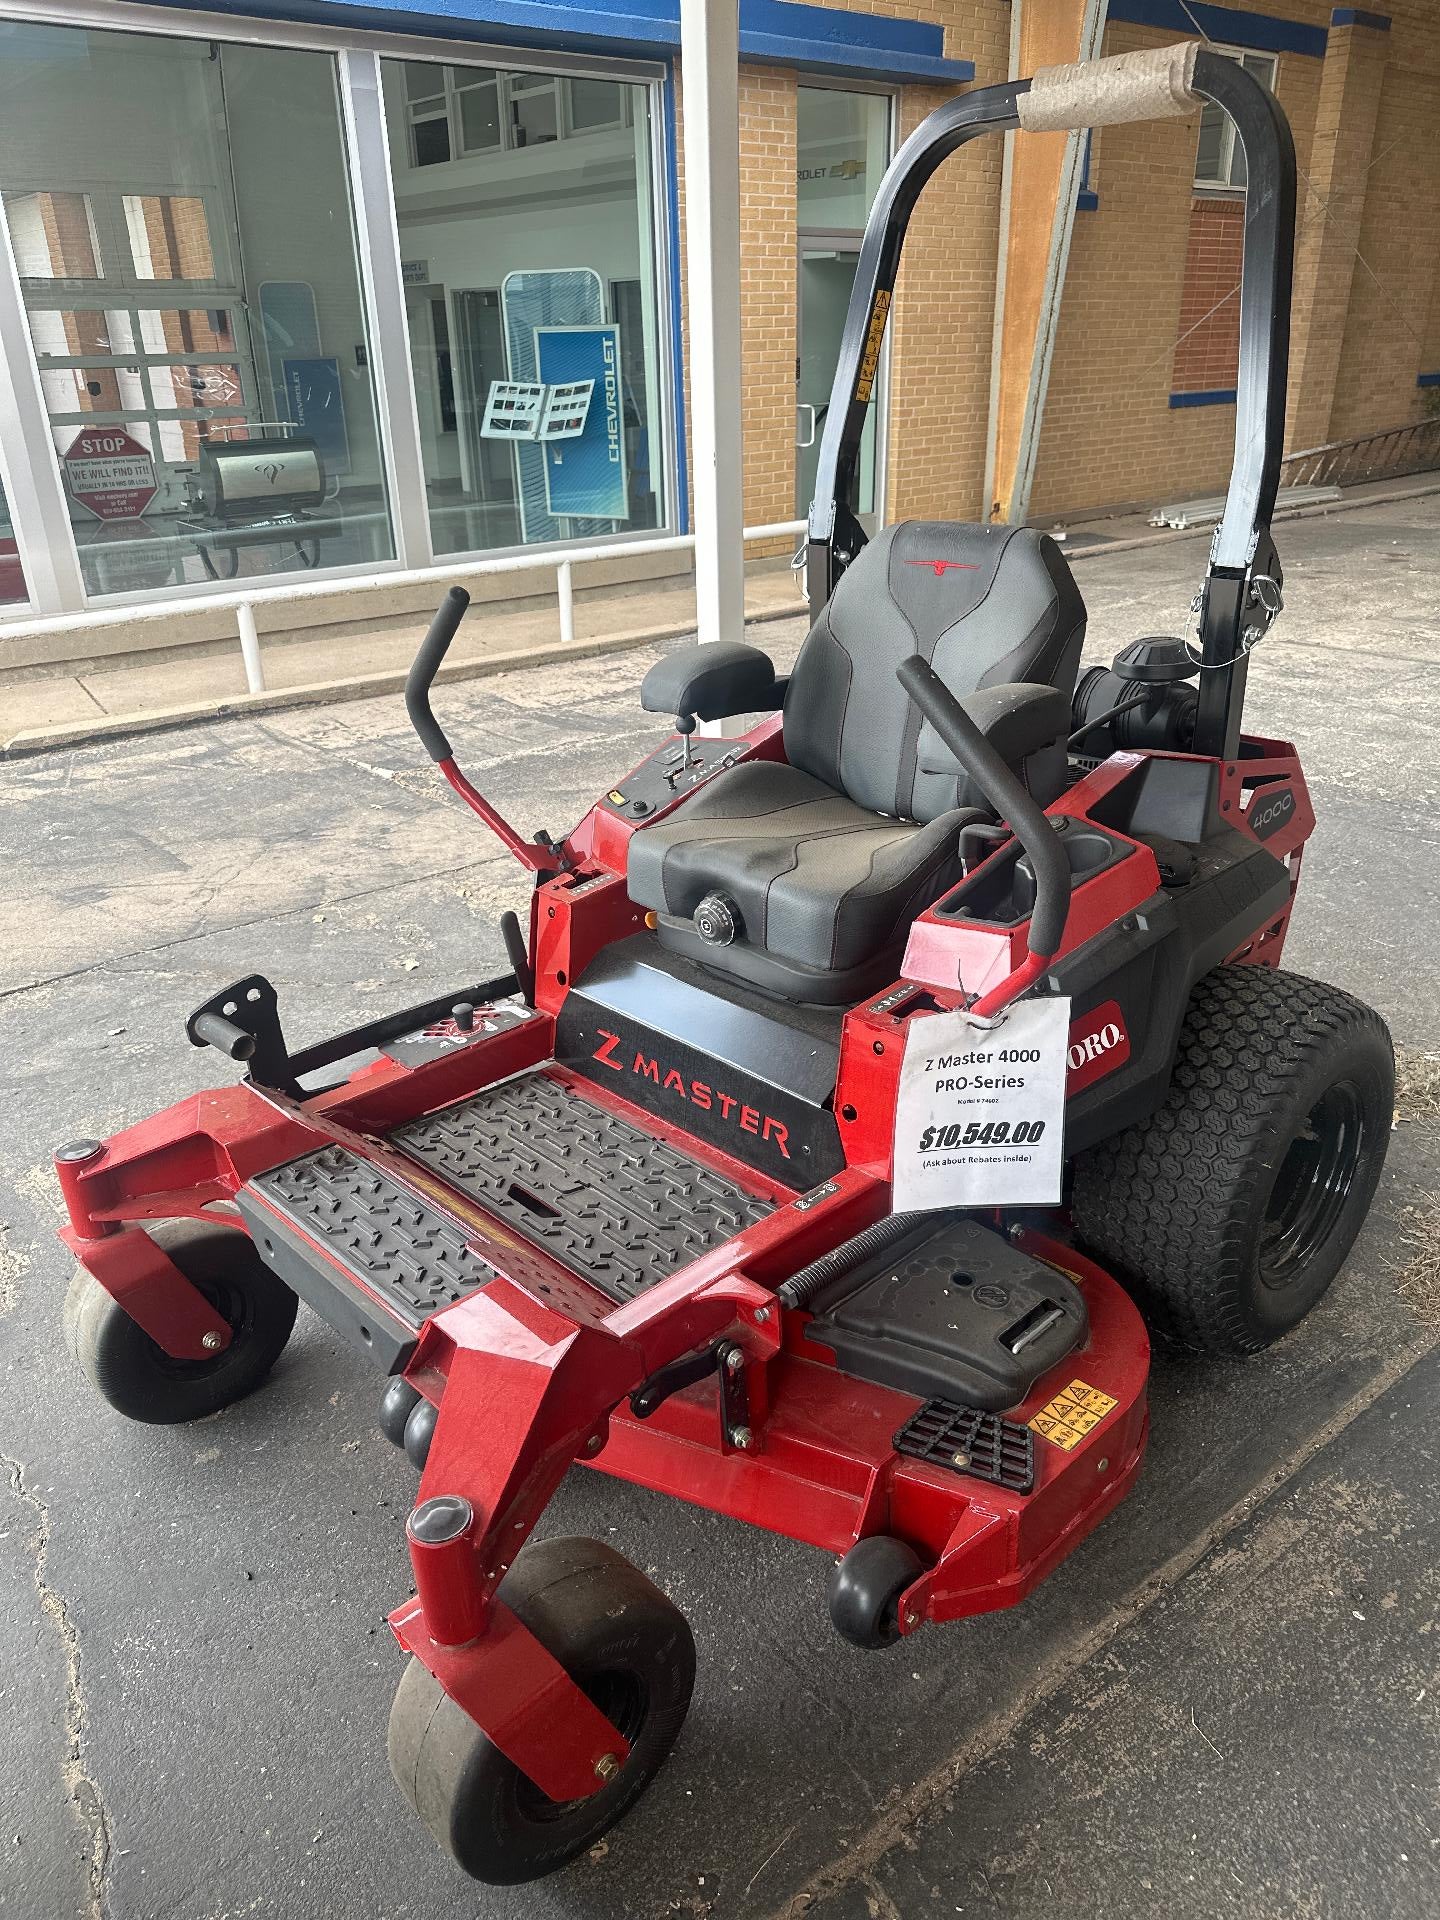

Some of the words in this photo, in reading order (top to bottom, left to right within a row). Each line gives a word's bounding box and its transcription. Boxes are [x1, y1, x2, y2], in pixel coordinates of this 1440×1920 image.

[797, 168, 827, 180] ROLET
[293, 371, 305, 427] CHEVROLET
[603, 337, 619, 462] CHEVROLET
[82, 438, 125, 454] STOP
[72, 470, 87, 480] WE
[89, 467, 111, 478] WILL
[113, 466, 133, 477] FIND
[1253, 794, 1292, 828] 4000
[1067, 1023, 1120, 1069] ORO
[924, 1059, 934, 1071] Z
[938, 1051, 994, 1070] Master
[998, 1049, 1041, 1063] 4000
[592, 1028, 624, 1071] Z
[632, 1052, 791, 1159] MASTER
[935, 1074, 1025, 1093] PRO-Series
[919, 1120, 1046, 1150] $10,549.00
[922, 1159, 941, 1169] (Ask
[941, 1156, 966, 1166] about
[968, 1156, 1001, 1164] Rebates
[1003, 1154, 1032, 1164] inside)
